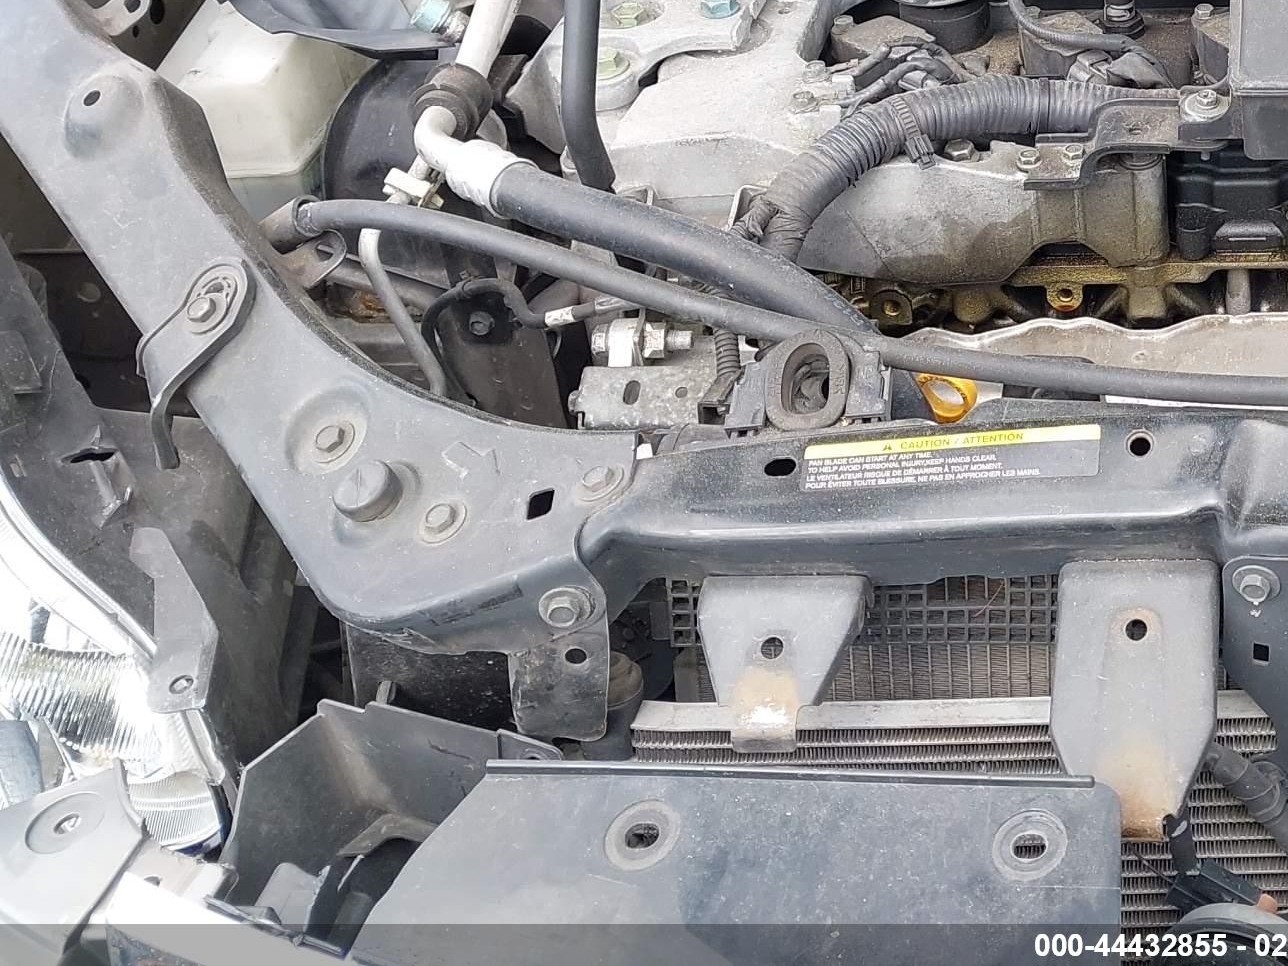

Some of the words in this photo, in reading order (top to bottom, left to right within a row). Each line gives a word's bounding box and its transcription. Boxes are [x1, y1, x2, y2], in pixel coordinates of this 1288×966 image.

[900, 436, 951, 450] CAUTION
[962, 432, 1024, 445] ATTENTION
[899, 453, 914, 461] ANY
[808, 466, 818, 474] TO
[819, 465, 837, 473] HELP
[838, 463, 861, 472] AVOID
[862, 461, 900, 470] PERSONAL
[945, 456, 970, 464] HANDS
[945, 473, 956, 481] EN
